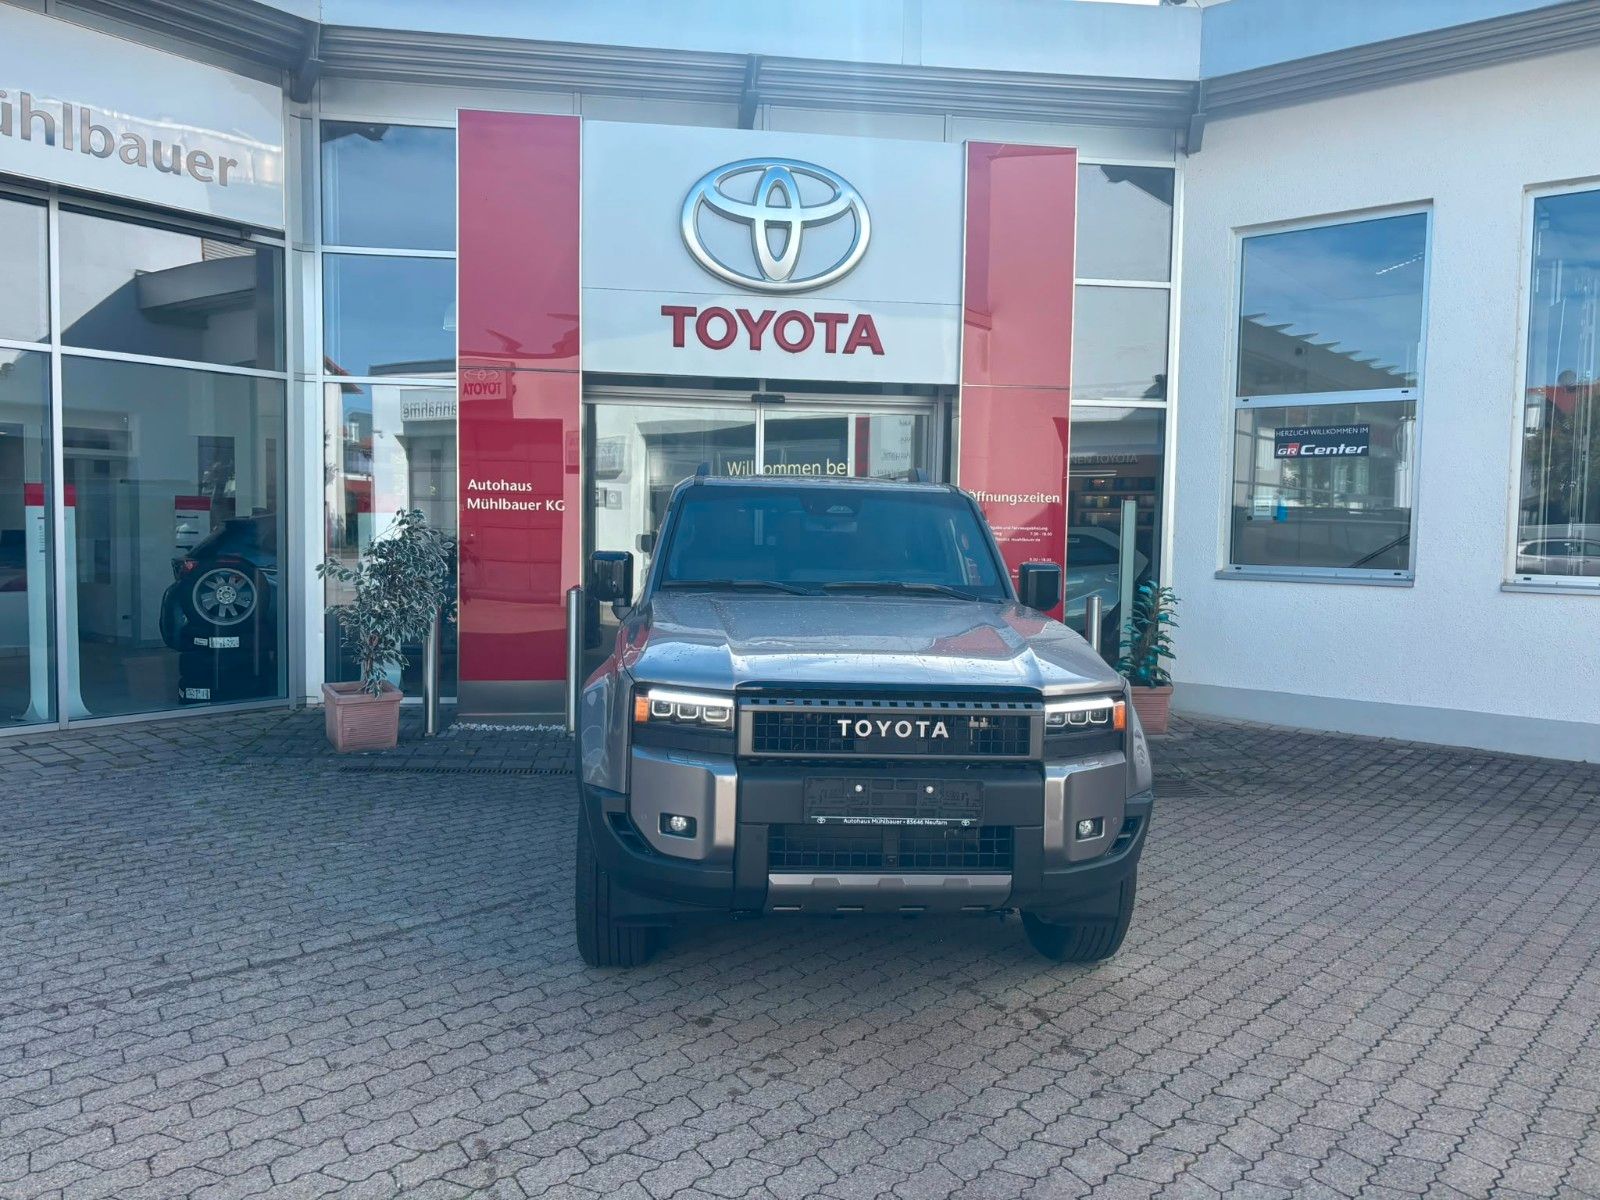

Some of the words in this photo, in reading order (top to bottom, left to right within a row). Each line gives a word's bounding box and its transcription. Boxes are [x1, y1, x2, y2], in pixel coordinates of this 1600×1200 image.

[661, 305, 885, 355] TOYOTA
[1311, 427, 1358, 435] WILLKOMMEN
[1278, 447, 1298, 455] GR
[1300, 444, 1367, 455] Center
[727, 459, 820, 476] Willommen
[467, 478, 532, 491] Autohaus
[467, 497, 541, 511] Mühlbauer
[546, 499, 565, 511] KG
[968, 489, 1060, 506] Öffnungszeiten
[837, 719, 949, 738] TOYOTA
